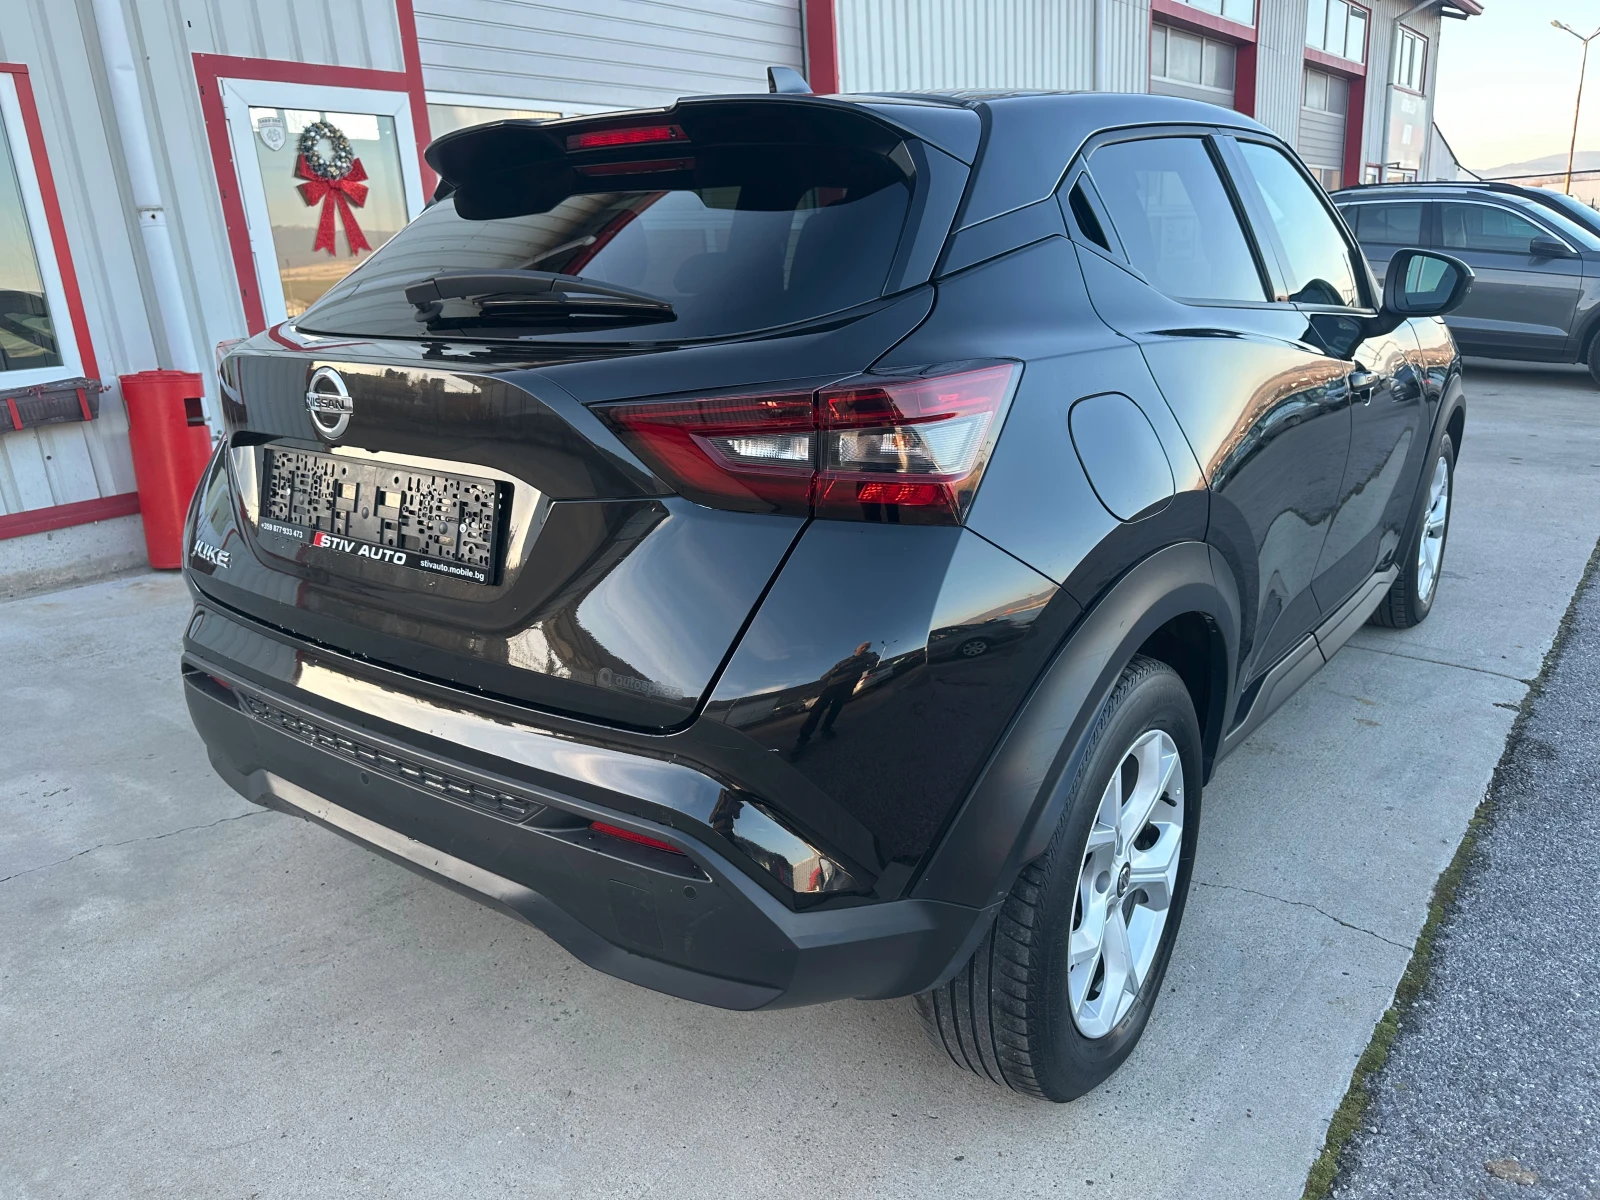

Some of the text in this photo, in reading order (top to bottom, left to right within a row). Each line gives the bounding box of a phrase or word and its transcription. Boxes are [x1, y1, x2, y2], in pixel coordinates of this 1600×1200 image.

[307, 396, 345, 410] NISSAN
[261, 522, 303, 539] +359 877 933 473
[190, 540, 233, 569] JUKE
[320, 534, 407, 566] STIV AUTO
[420, 560, 485, 582] stivauto.mobile.bg
